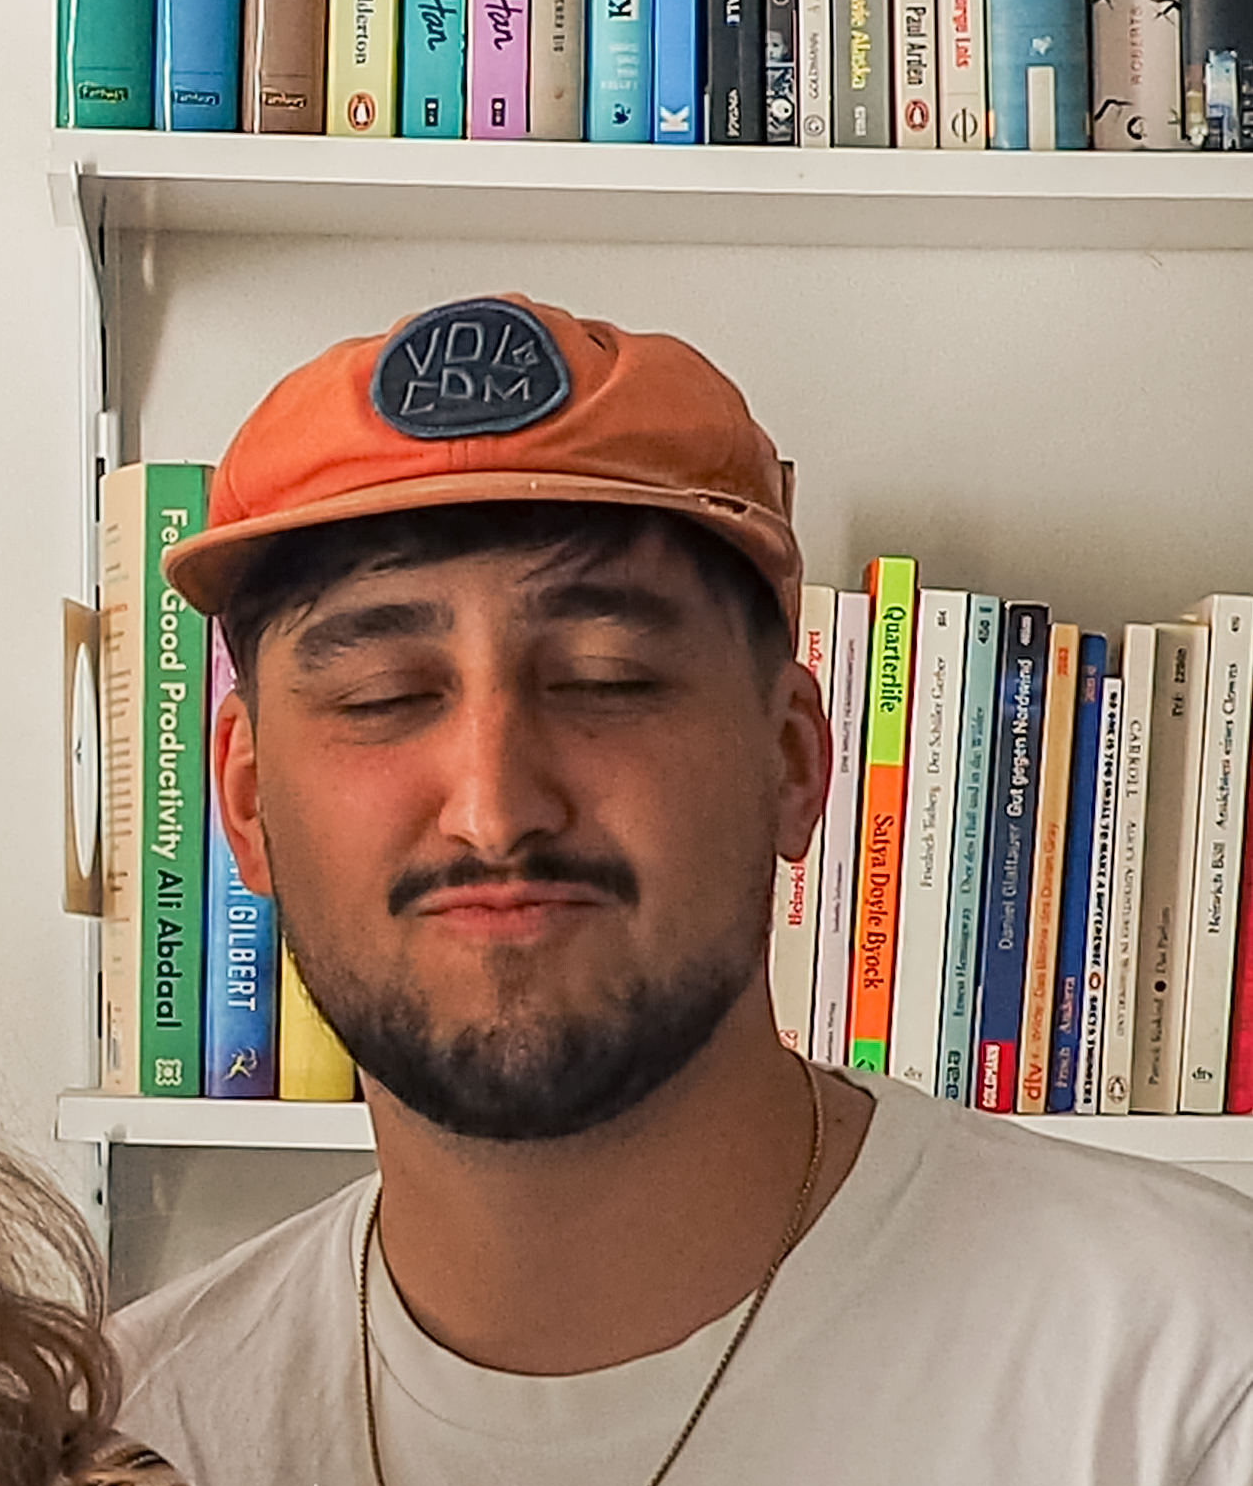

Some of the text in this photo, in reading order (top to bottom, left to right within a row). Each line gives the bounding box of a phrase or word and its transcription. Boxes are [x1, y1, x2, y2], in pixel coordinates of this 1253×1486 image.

[880, 606, 907, 713] Quarterlife
[150, 681, 187, 860] Productivity
[1006, 789, 1024, 817] Gut
[156, 869, 184, 909] Ali
[864, 873, 891, 926] Doyle
[155, 918, 184, 1028] Abdaal
[226, 905, 258, 1013] GILBERT
[861, 931, 888, 990] Byock
